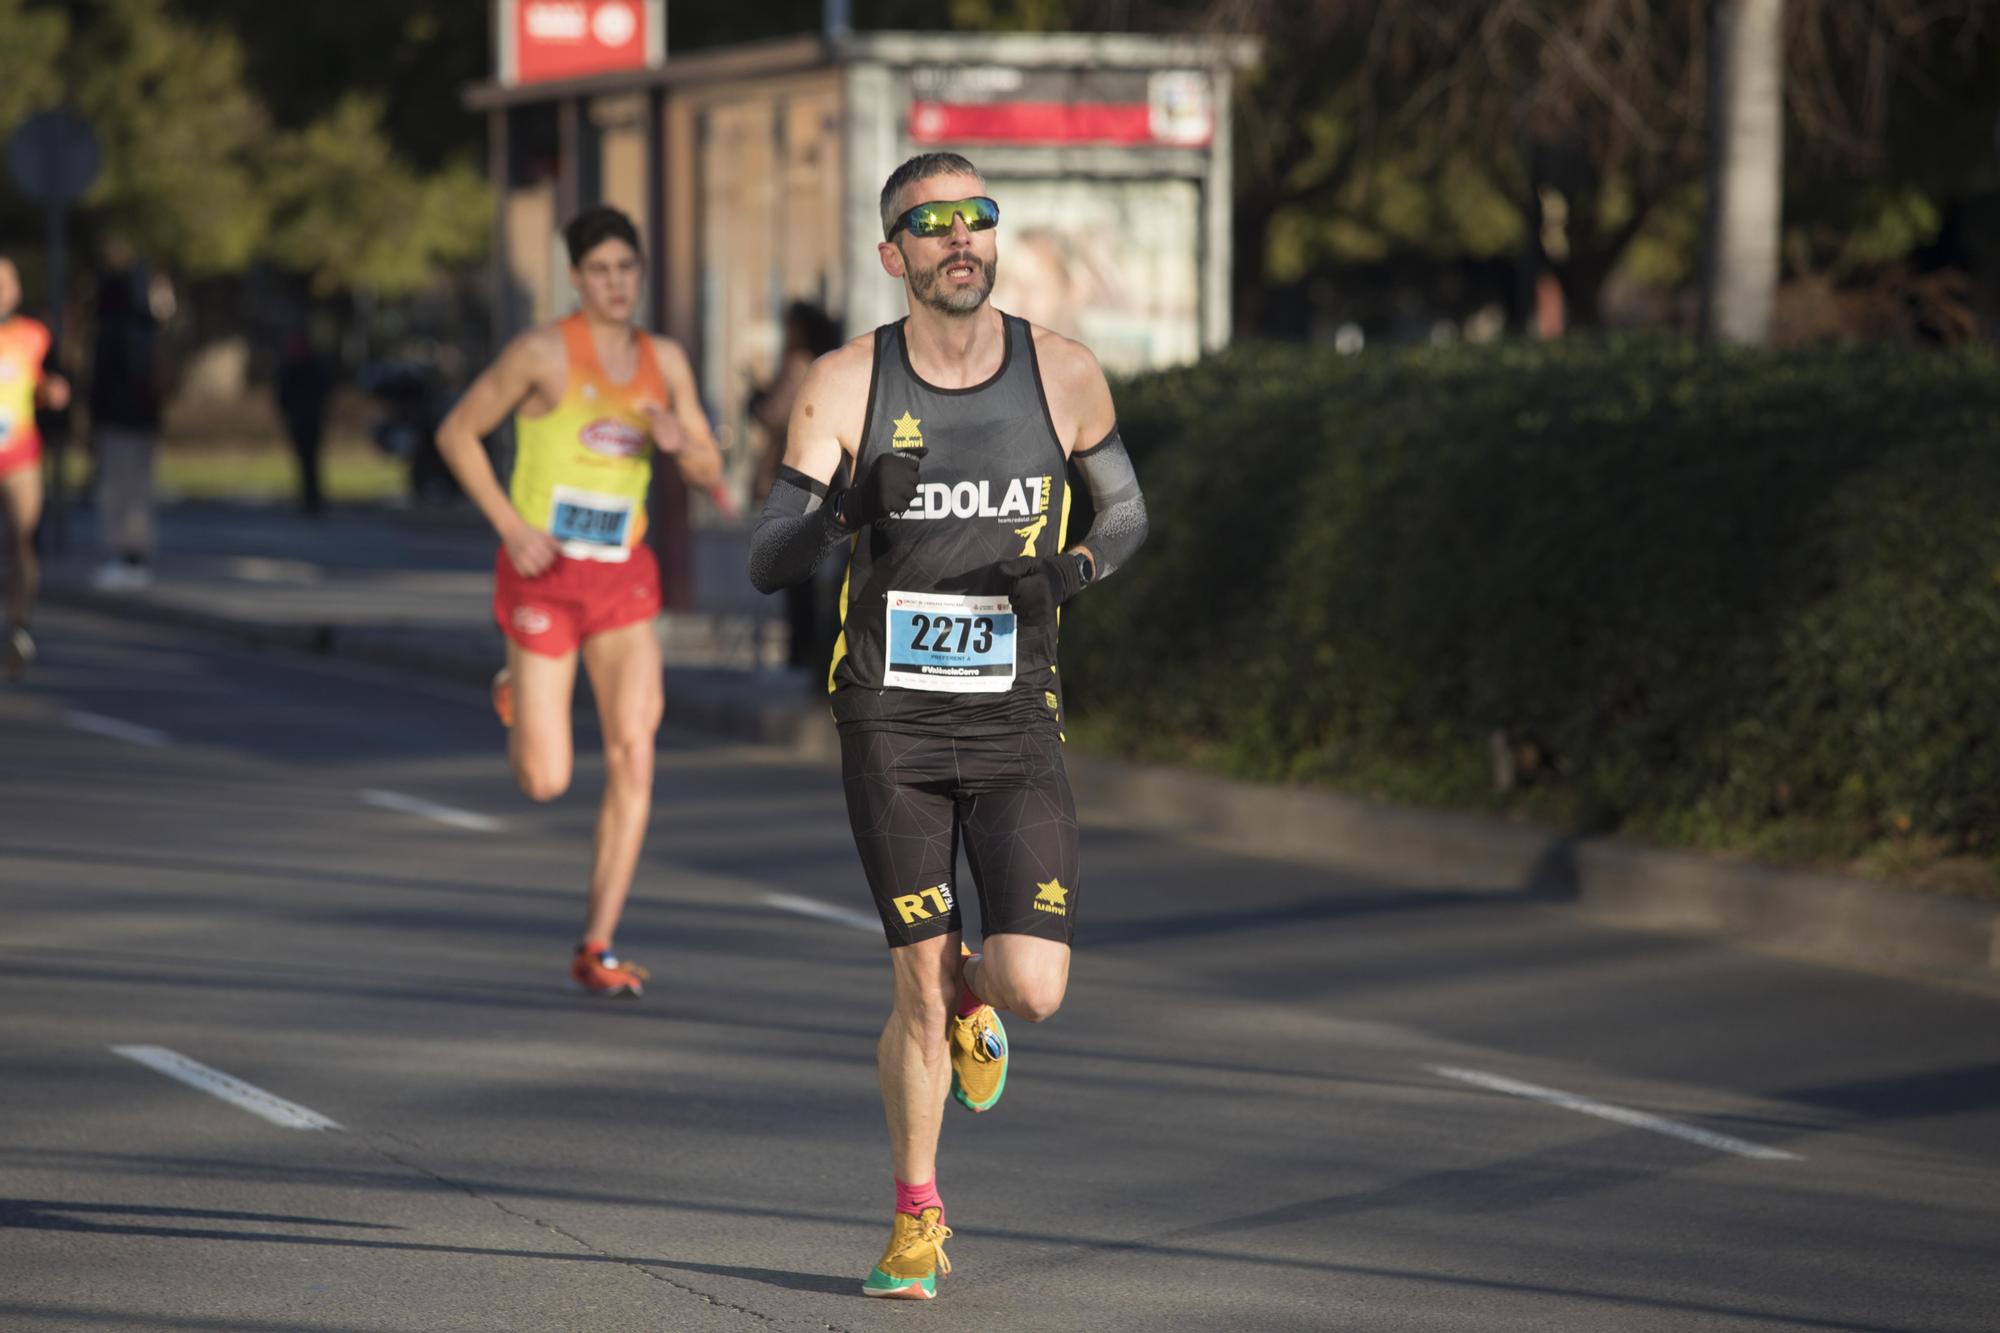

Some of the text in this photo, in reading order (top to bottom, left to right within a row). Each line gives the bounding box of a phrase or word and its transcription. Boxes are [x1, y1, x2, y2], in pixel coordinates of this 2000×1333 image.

[892, 438, 923, 448] luanvi
[889, 477, 1042, 520] EDOLAT
[1040, 475, 1053, 512] TEAM
[911, 614, 994, 654] 2273
[892, 886, 949, 924] RT
[939, 883, 954, 910] TEAM
[1033, 900, 1066, 917] luanvi
